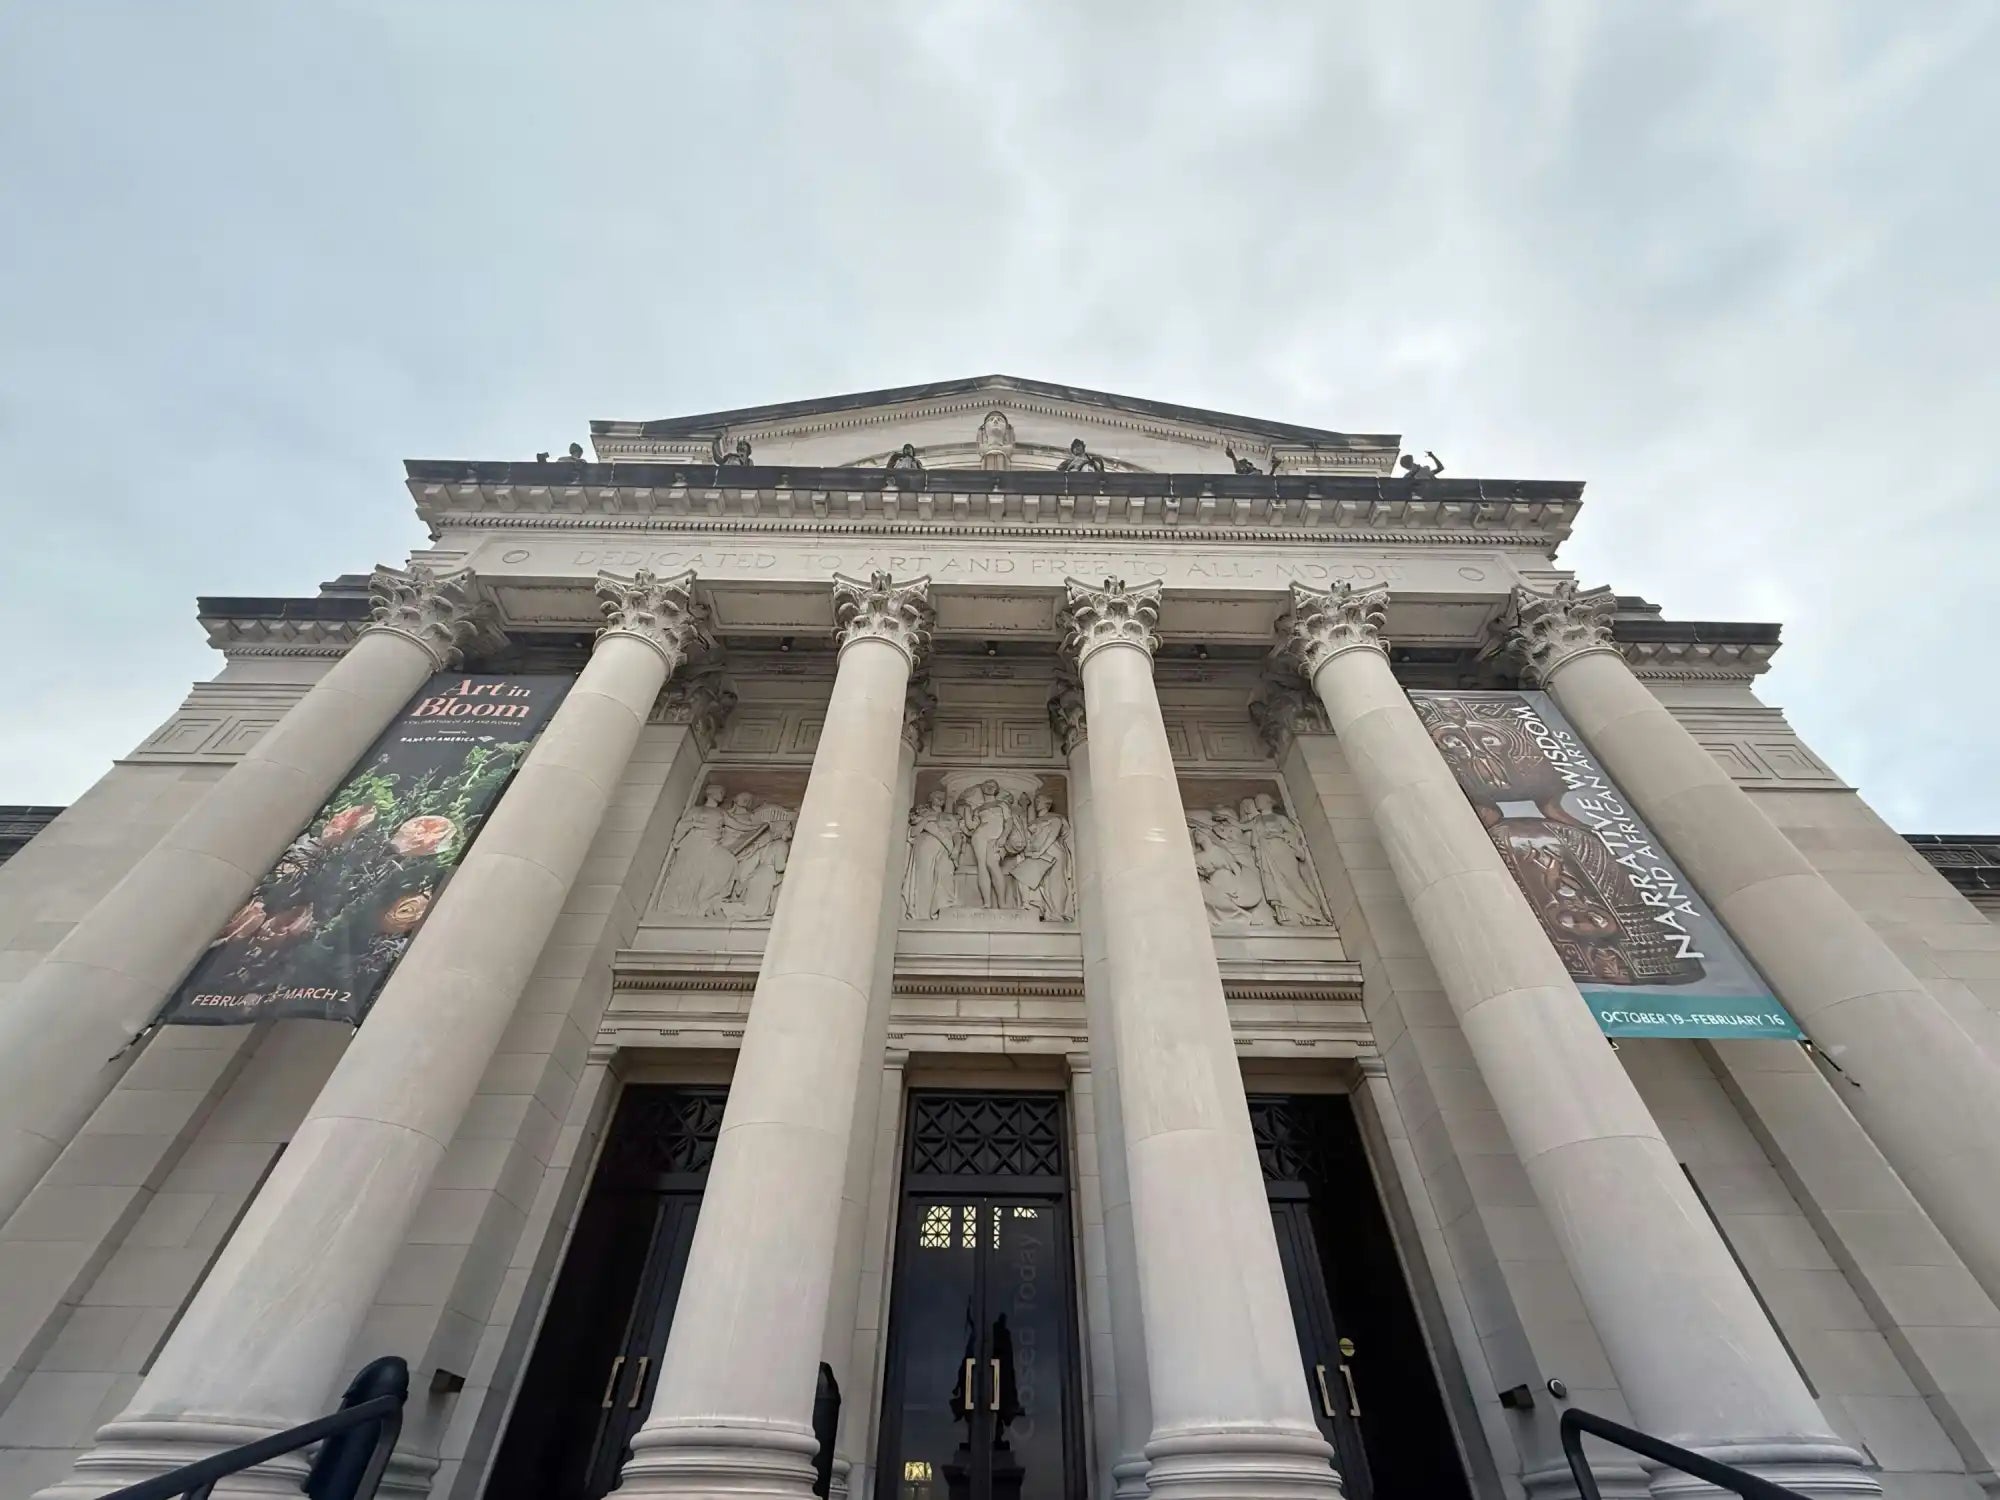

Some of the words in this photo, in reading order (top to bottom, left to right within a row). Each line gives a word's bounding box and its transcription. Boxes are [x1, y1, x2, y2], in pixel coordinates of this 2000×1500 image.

[572, 550, 777, 569] DEDICATED
[798, 554, 843, 570] TO
[858, 556, 932, 571] ART
[940, 557, 1016, 573] AND
[1032, 559, 1113, 575] FREE
[1124, 560, 1168, 576] TO
[410, 697, 530, 717] Bloom
[440, 679, 506, 696] Art
[507, 685, 531, 697] in
[1511, 705, 1587, 790] WISDOM
[1552, 730, 1595, 771] ARTS
[1583, 775, 1659, 860] AFRICAN
[1576, 798, 1705, 959] NARRATIVE
[1650, 866, 1701, 917] AND
[338, 991, 352, 1002] 2
[1600, 1011, 1668, 1024] OCTOBER
[1764, 1013, 1785, 1026] 16
[1014, 1232, 1042, 1314] Today
[1011, 1326, 1037, 1441] Cosed
